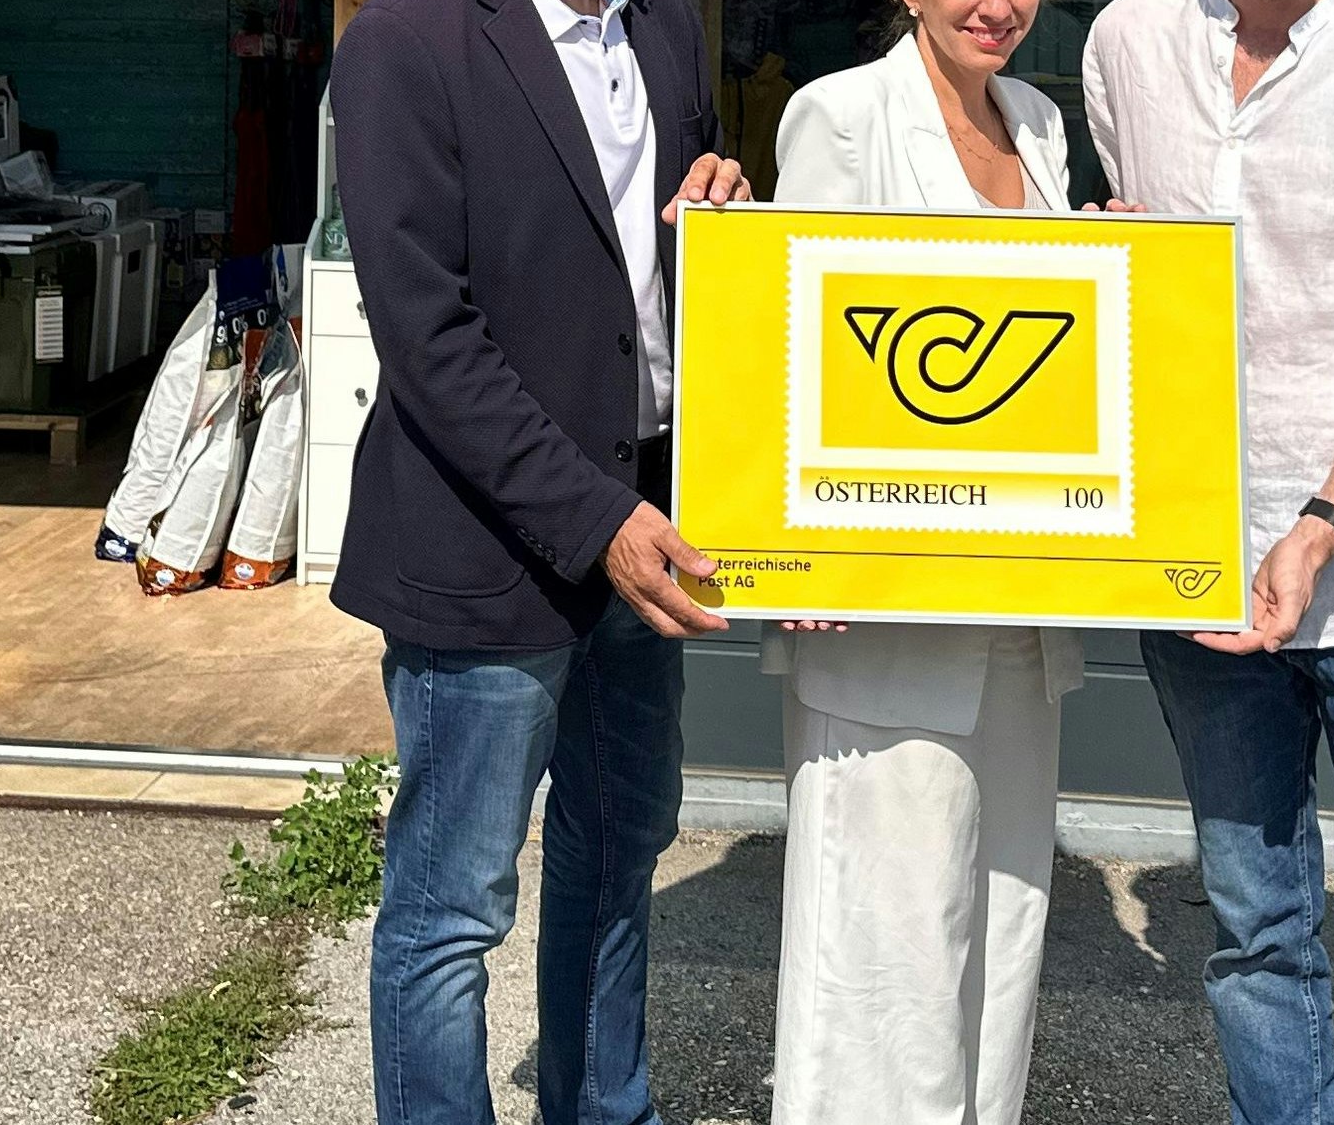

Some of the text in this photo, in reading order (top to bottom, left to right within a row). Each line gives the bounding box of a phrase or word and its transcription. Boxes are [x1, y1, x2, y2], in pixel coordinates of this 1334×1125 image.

[814, 476, 987, 507] ÖSTERREICH
[1063, 486, 1104, 510] 100
[704, 554, 812, 572] terreichische
[698, 575, 755, 588] Post AG
